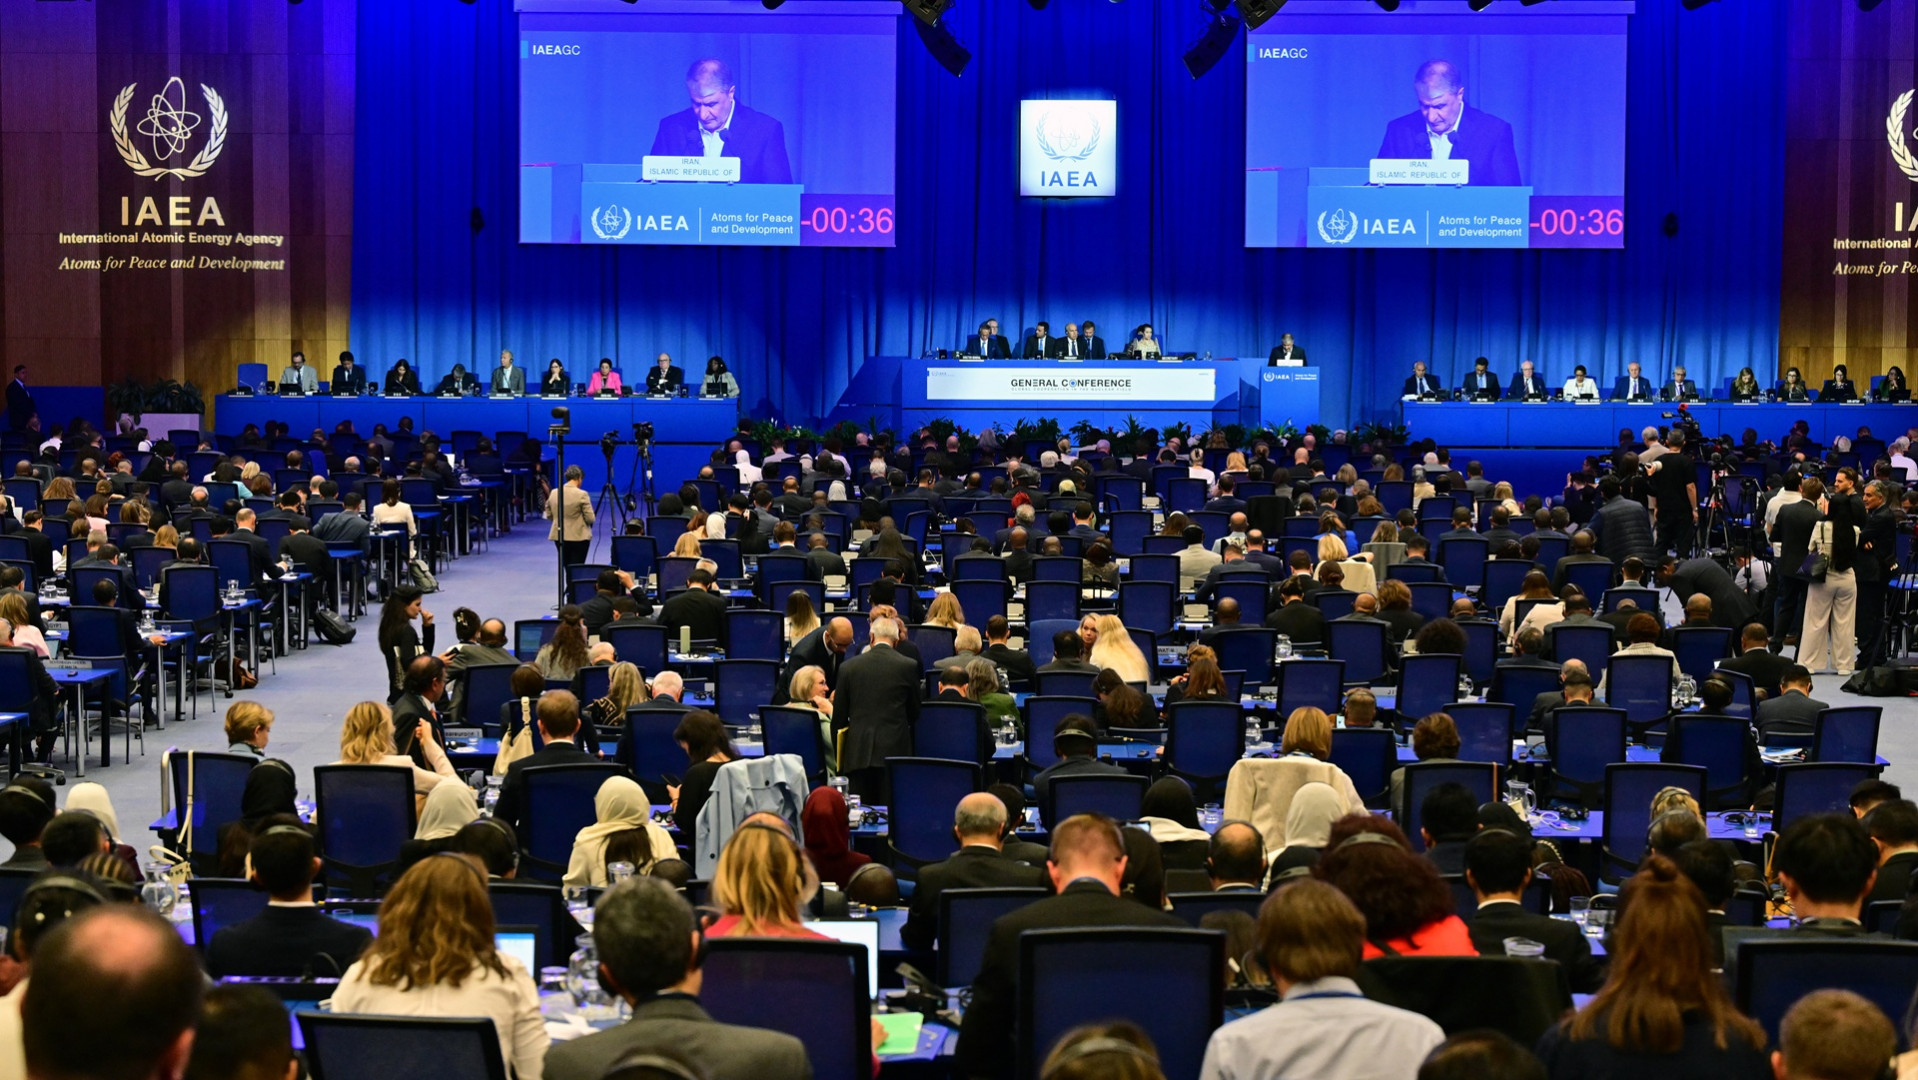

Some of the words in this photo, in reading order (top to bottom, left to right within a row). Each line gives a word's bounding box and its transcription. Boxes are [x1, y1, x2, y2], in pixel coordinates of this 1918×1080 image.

[533, 45, 581, 55] IAEAGC
[1259, 48, 1308, 59] IAEAGC
[682, 168, 719, 176] REPUBLIC
[1376, 171, 1406, 179] ISLAMIC
[1410, 171, 1447, 179] REPUBLIC
[1041, 170, 1098, 187] IAEA
[121, 196, 226, 226] IAEA
[637, 215, 690, 231] IAEA
[711, 213, 742, 222] Atoms
[745, 213, 758, 222] for
[762, 213, 793, 223] Peace
[1438, 216, 1472, 225] Atoms
[1473, 216, 1488, 225] for
[1490, 216, 1522, 226] Peace
[711, 224, 729, 234] and
[731, 224, 793, 236] Development
[1363, 218, 1417, 235] IAEA
[59, 232, 138, 244] International
[142, 231, 186, 244] Atomic
[189, 232, 232, 246] Energy
[235, 232, 284, 247] Agency
[1438, 227, 1457, 237] and
[1459, 227, 1522, 239] Development
[1833, 237, 1911, 249] International
[59, 256, 101, 270] Atoms
[103, 255, 126, 272] for
[128, 256, 166, 269] Peace
[171, 255, 196, 269] and
[199, 256, 285, 272] Development
[1833, 261, 1875, 275] Atoms
[1875, 260, 1899, 277] for
[1901, 260, 1918, 274] Pe
[1010, 378, 1059, 388] GENERAL
[1061, 378, 1131, 388] CONFERENCE
